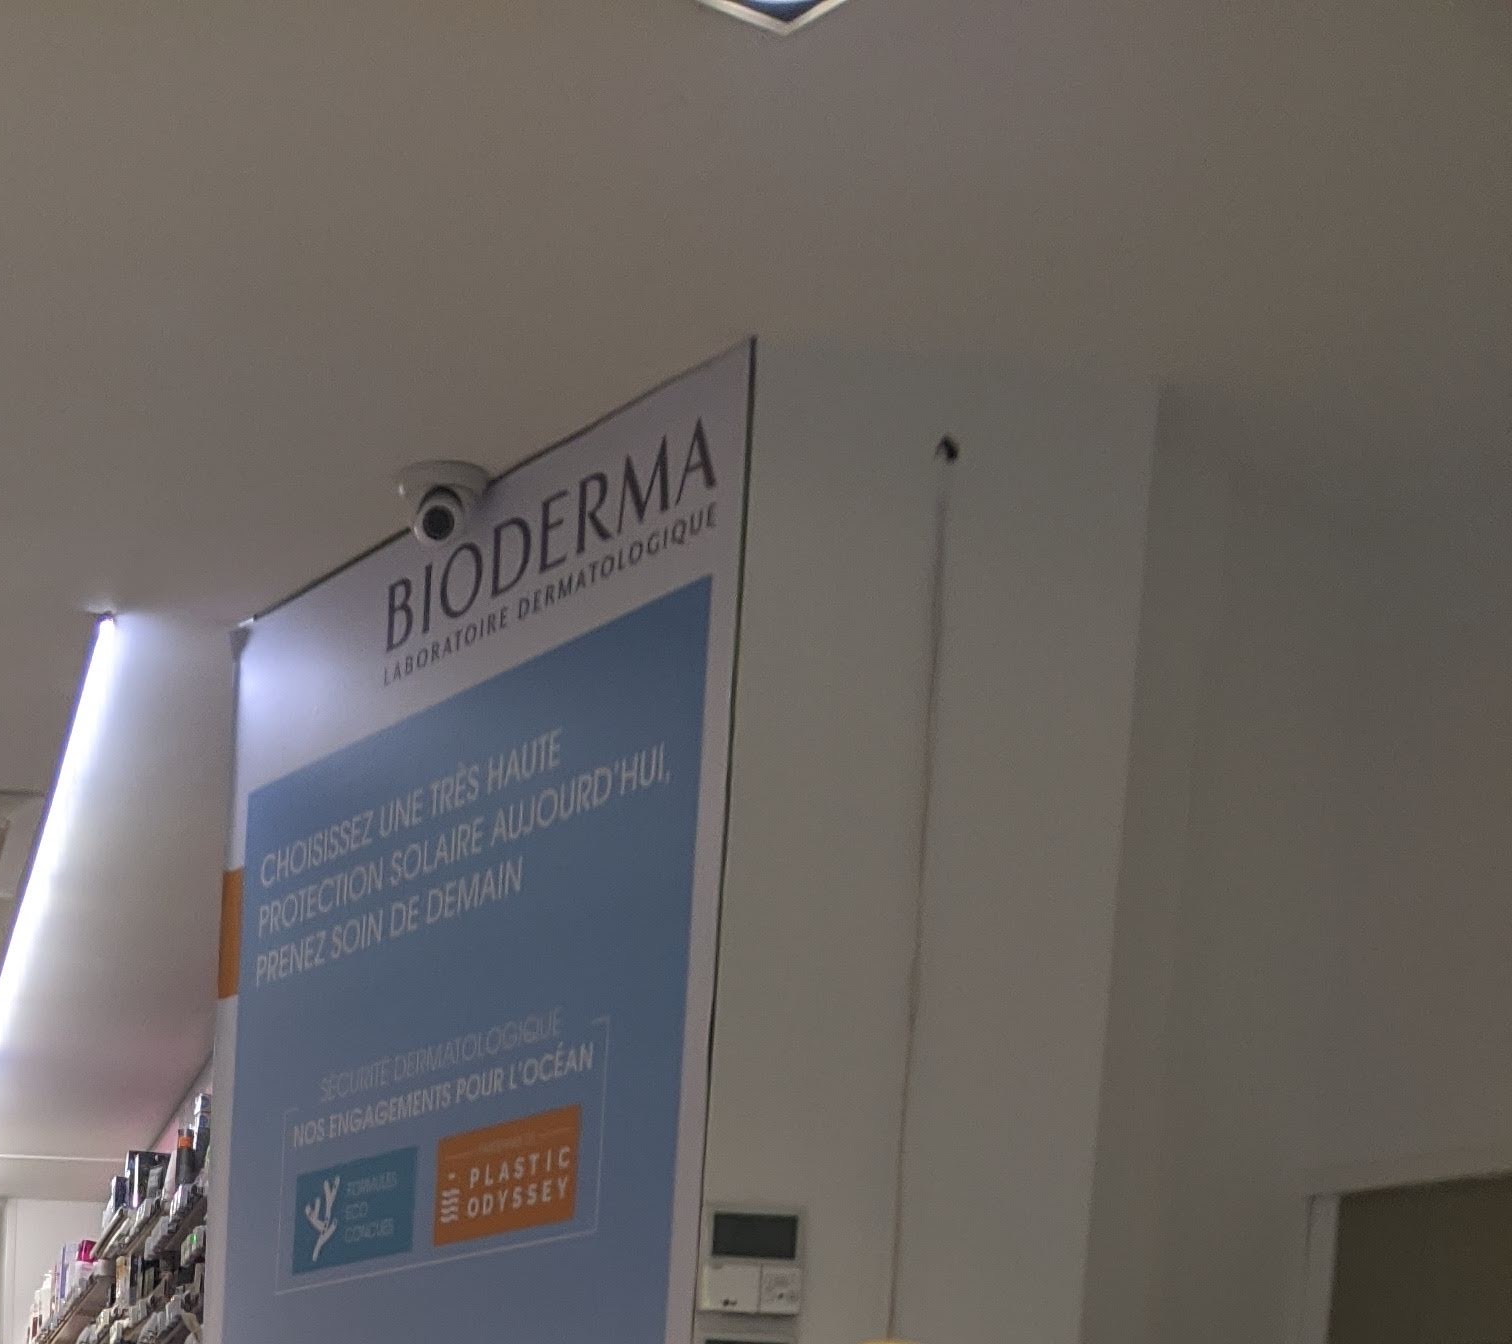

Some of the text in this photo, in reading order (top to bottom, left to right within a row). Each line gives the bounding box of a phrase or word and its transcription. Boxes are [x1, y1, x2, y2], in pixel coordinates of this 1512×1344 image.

[383, 501, 718, 687] LABORATOIRE DERMATOLOGIQUE
[386, 418, 718, 652] BIODERMA
[260, 728, 563, 888] CHOISISSEZ UNE TRÈS HAUTE
[256, 858, 524, 986] PRENEZ SOIN DE DEMAIN
[258, 855, 383, 938] PROTECTION
[389, 821, 483, 884] SOLAIRE
[293, 1041, 594, 1147] NOS ENGAGEMENTS POUR L'OCÉAN
[467, 1177, 569, 1219] ODYSSEY
[469, 1146, 570, 1189] PLASTIC
